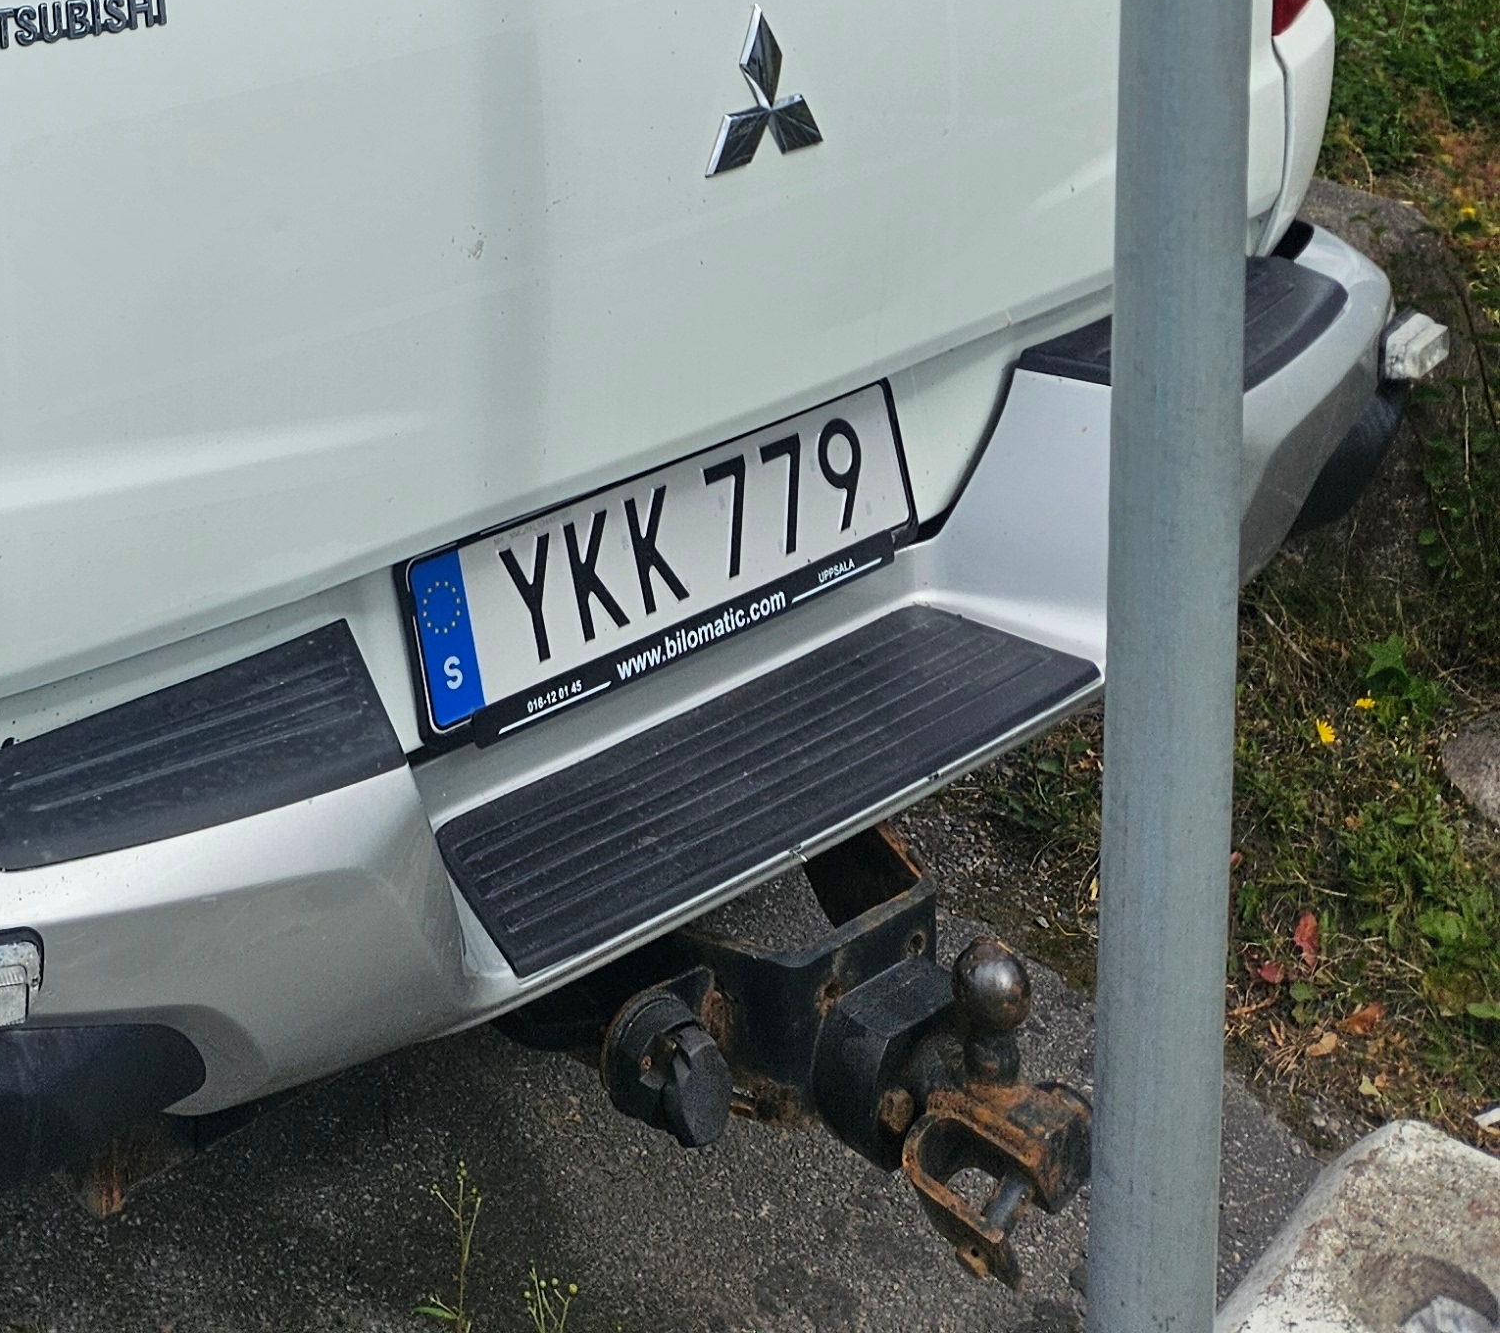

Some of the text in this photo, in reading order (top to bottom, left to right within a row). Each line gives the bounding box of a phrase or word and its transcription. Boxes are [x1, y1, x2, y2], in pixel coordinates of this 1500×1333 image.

[498, 417, 862, 663] YKK 779
[818, 558, 855, 583] UPPSALA
[616, 590, 787, 680] www.bilomatic.com
[443, 655, 464, 691] S
[571, 680, 582, 693] 45
